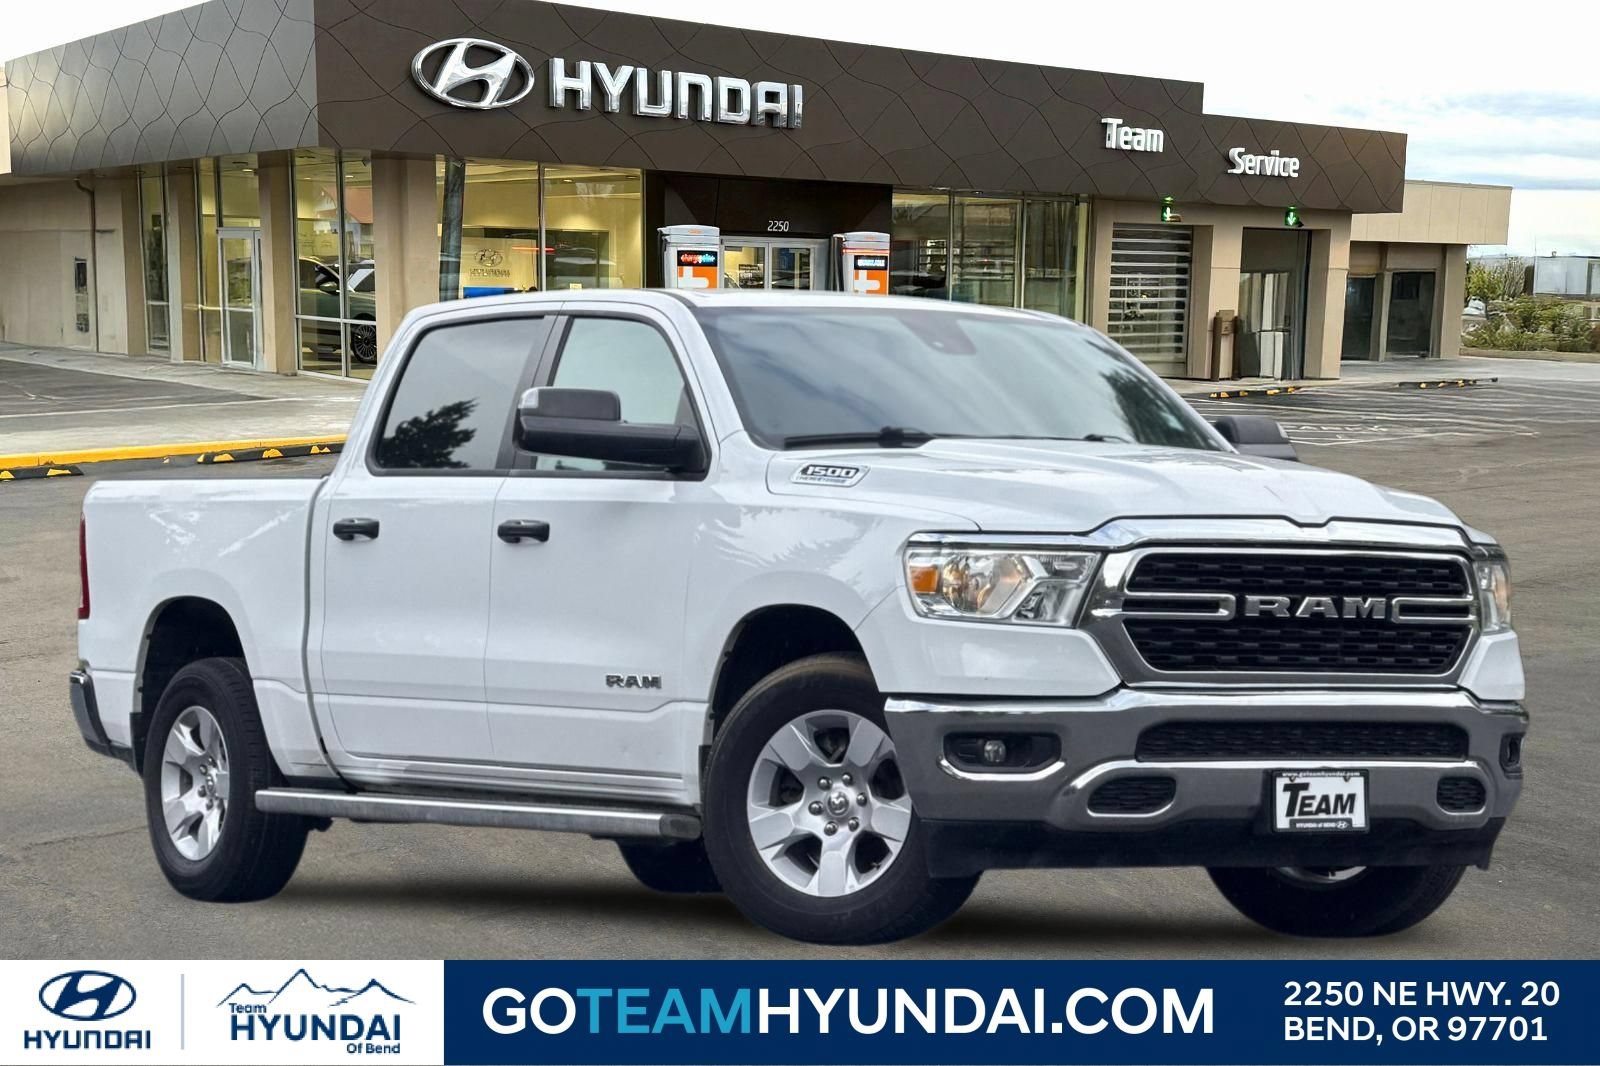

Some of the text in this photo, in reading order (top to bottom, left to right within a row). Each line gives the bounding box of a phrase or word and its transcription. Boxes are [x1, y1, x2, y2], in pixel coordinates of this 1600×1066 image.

[549, 57, 803, 129] HYUNDAI
[1101, 117, 1164, 153] Team
[1227, 147, 1300, 178] Service
[767, 220, 790, 232] 2250
[806, 465, 857, 478] 1500
[1244, 594, 1387, 619] RAM
[605, 672, 662, 690] RAM
[1283, 782, 1356, 817] TEAM
